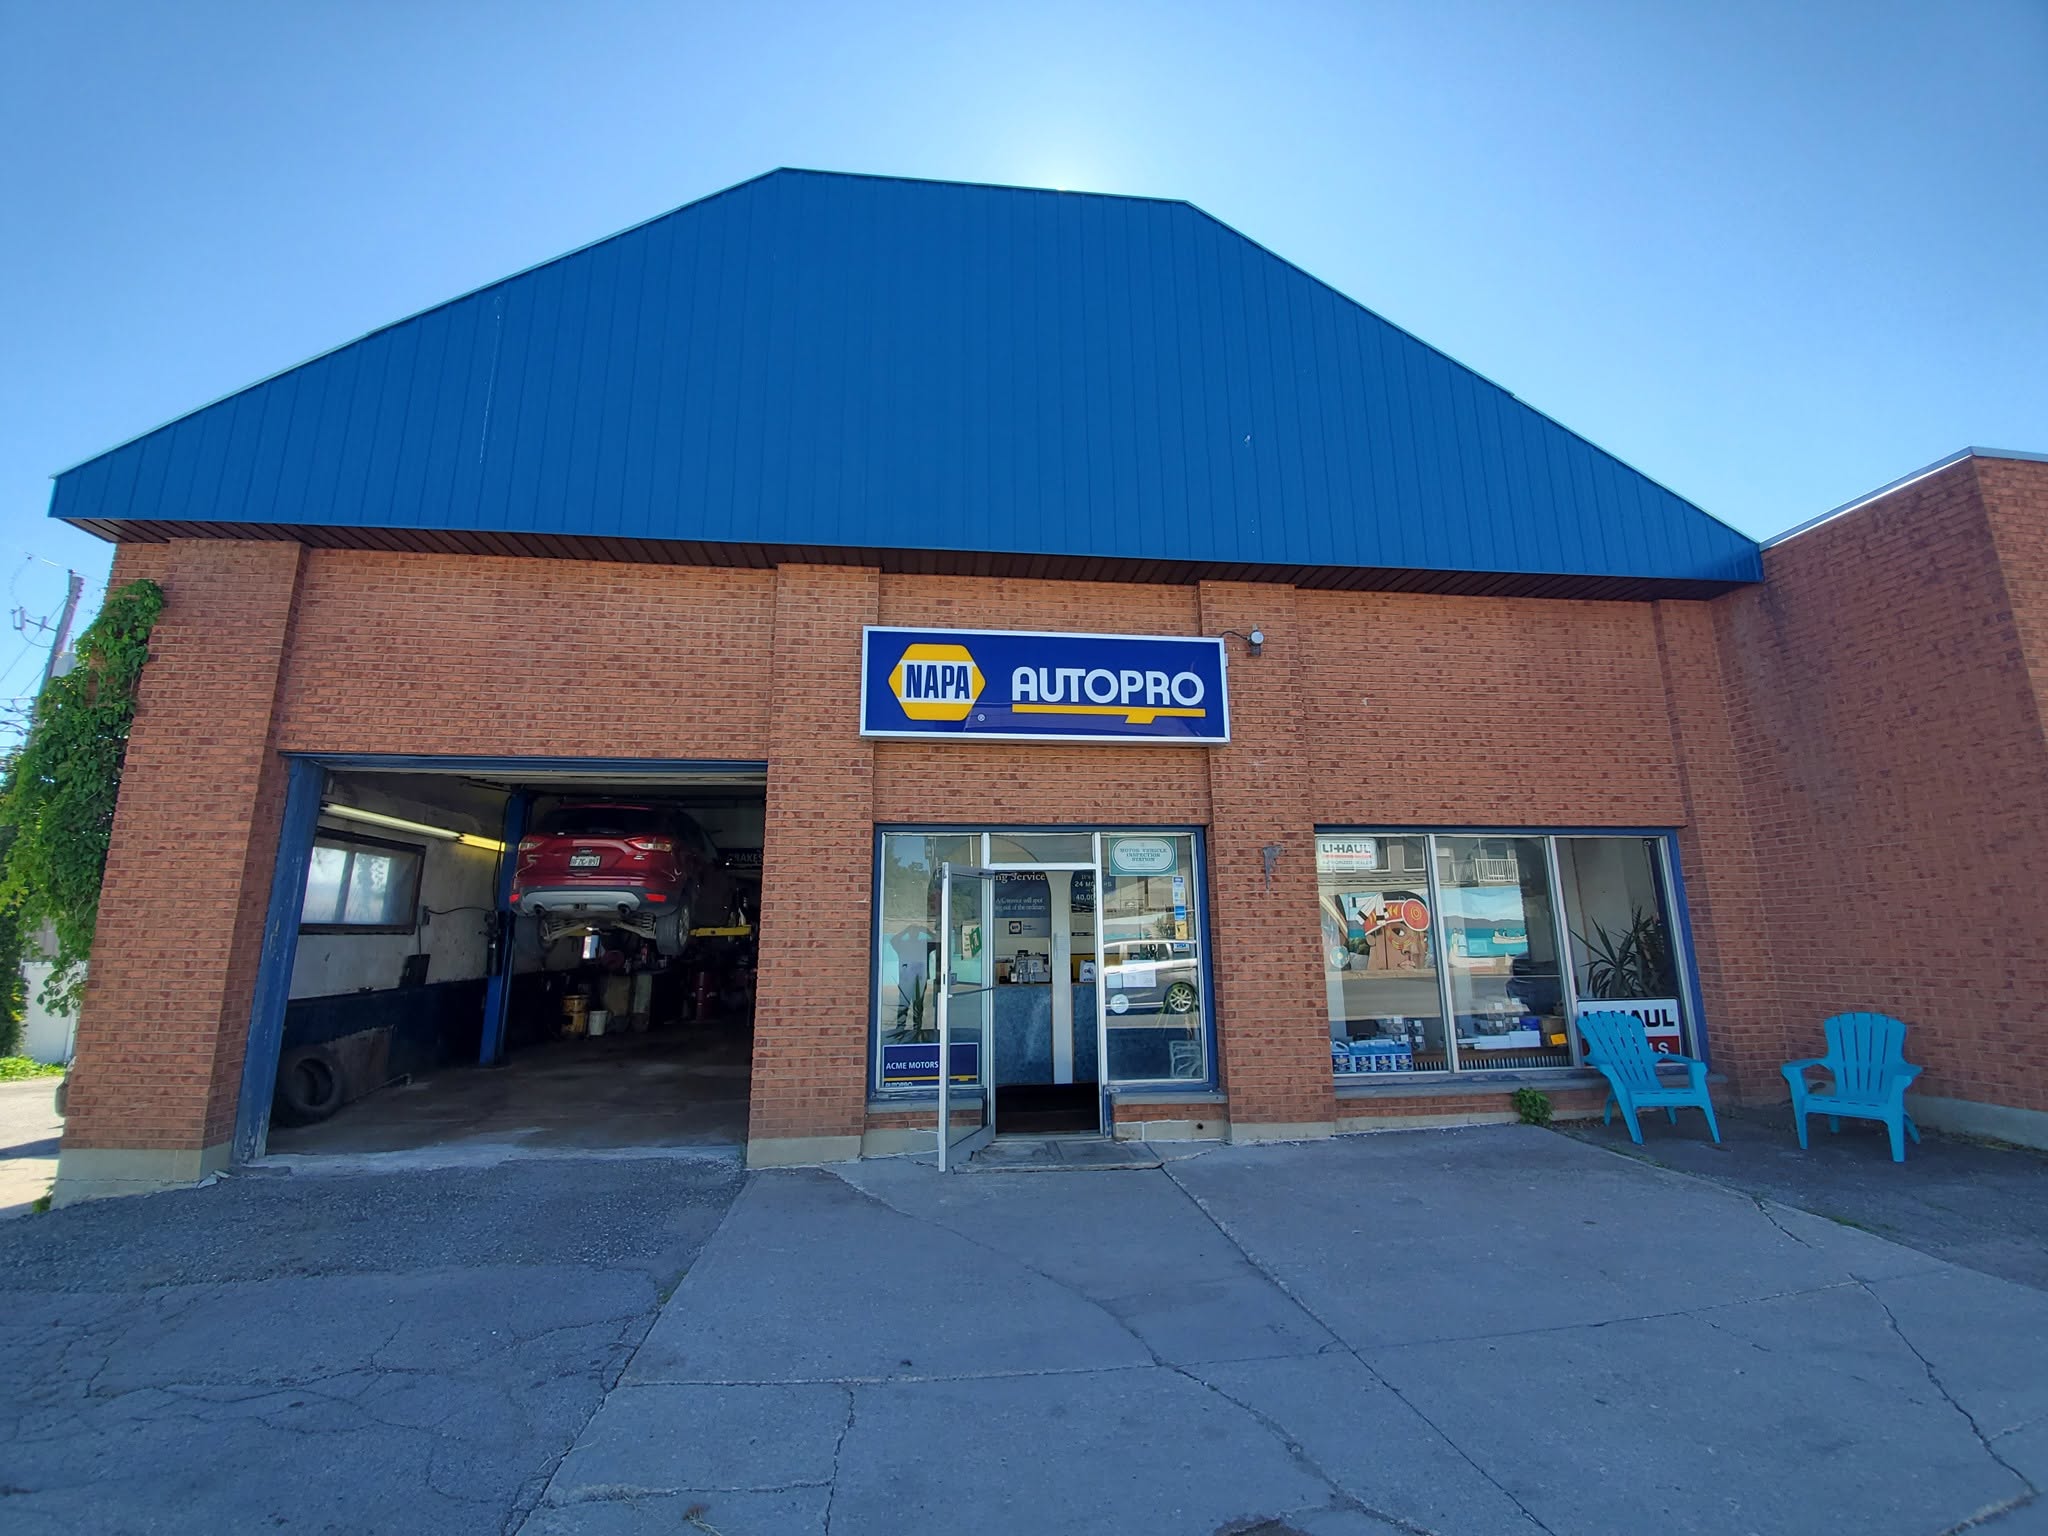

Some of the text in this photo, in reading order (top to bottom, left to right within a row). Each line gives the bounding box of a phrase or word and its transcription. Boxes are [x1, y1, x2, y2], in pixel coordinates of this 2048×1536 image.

[906, 664, 970, 700] NAPA
[1011, 666, 1206, 706] AUTOPRO
[886, 1061, 939, 1070] ACME MOTORS
